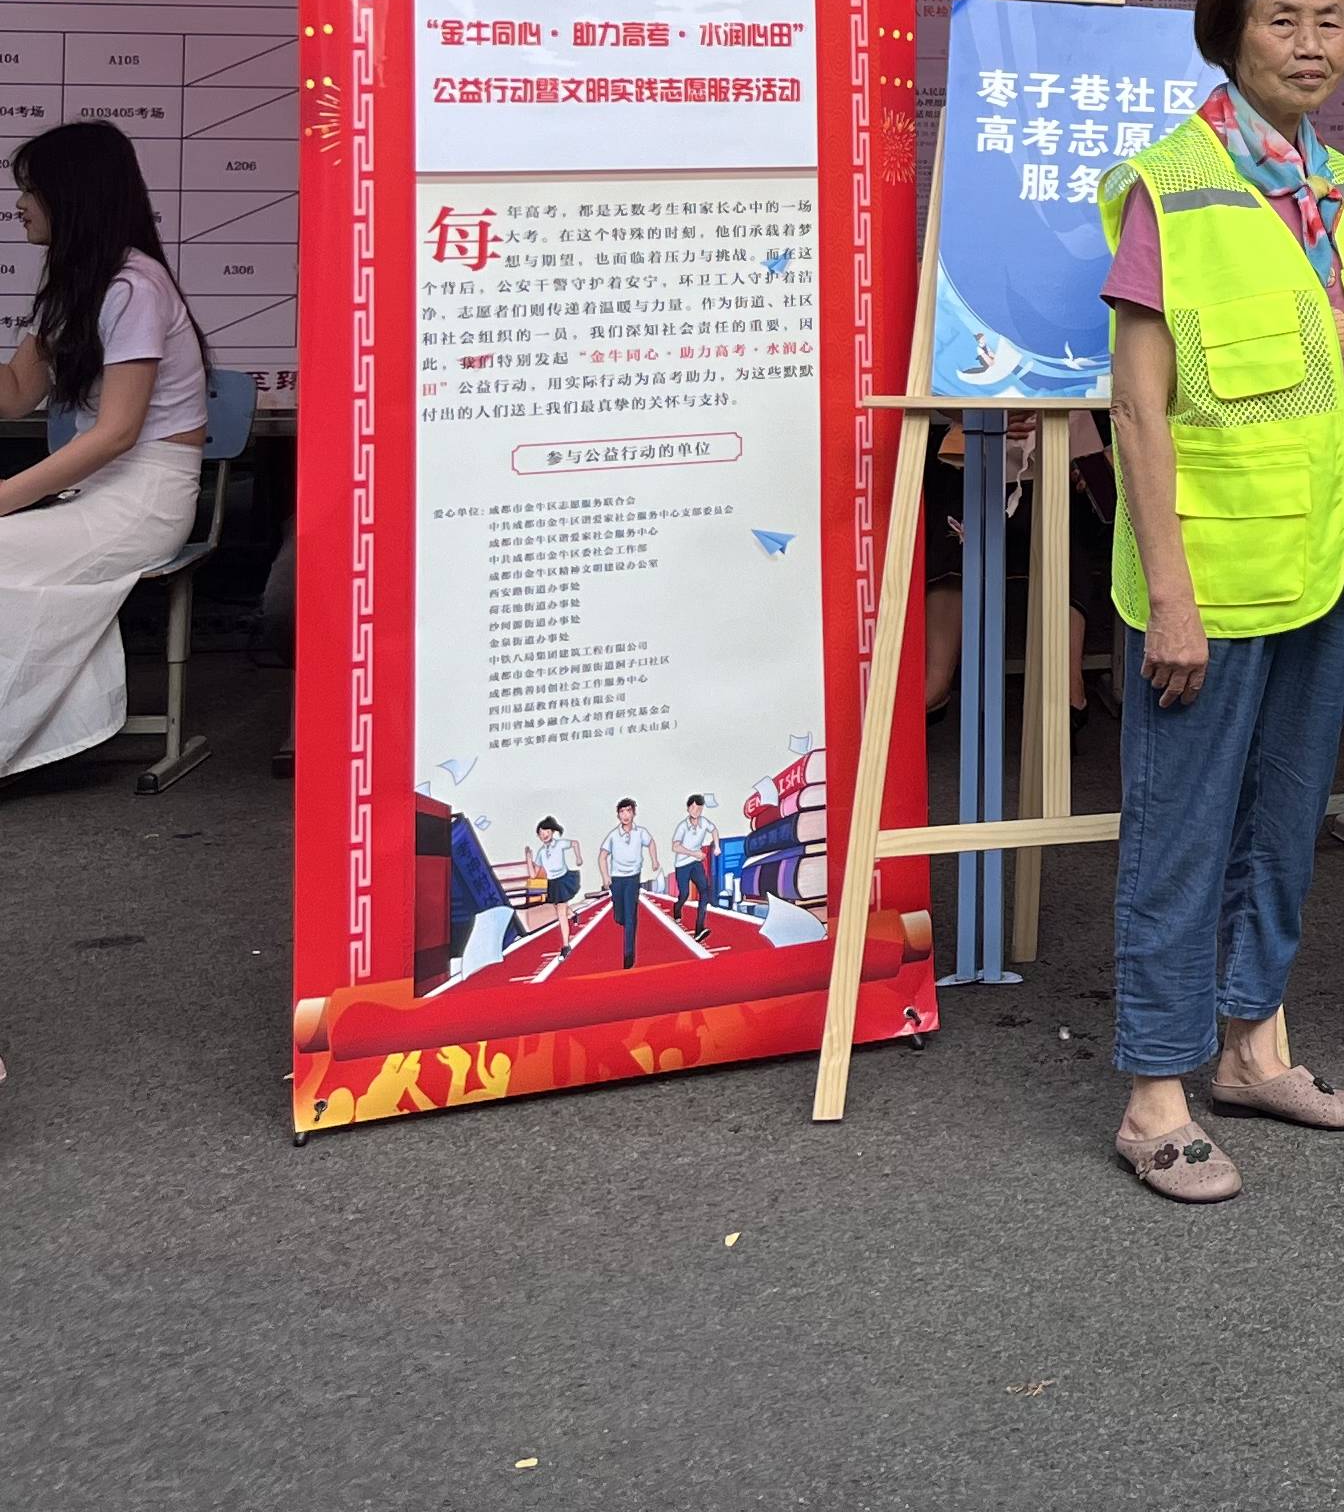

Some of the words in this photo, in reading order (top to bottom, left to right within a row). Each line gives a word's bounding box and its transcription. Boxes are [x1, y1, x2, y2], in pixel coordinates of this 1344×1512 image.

[109, 55, 140, 65] A105
[433, 77, 801, 104] 公益行动暨文明实践志愿服务活动
[976, 69, 1198, 115] 枣子巷社区
[81, 106, 165, 119] 0103405考场
[226, 161, 257, 172] A206
[424, 206, 504, 272] 每
[546, 441, 711, 466] 参与公益行动的单位
